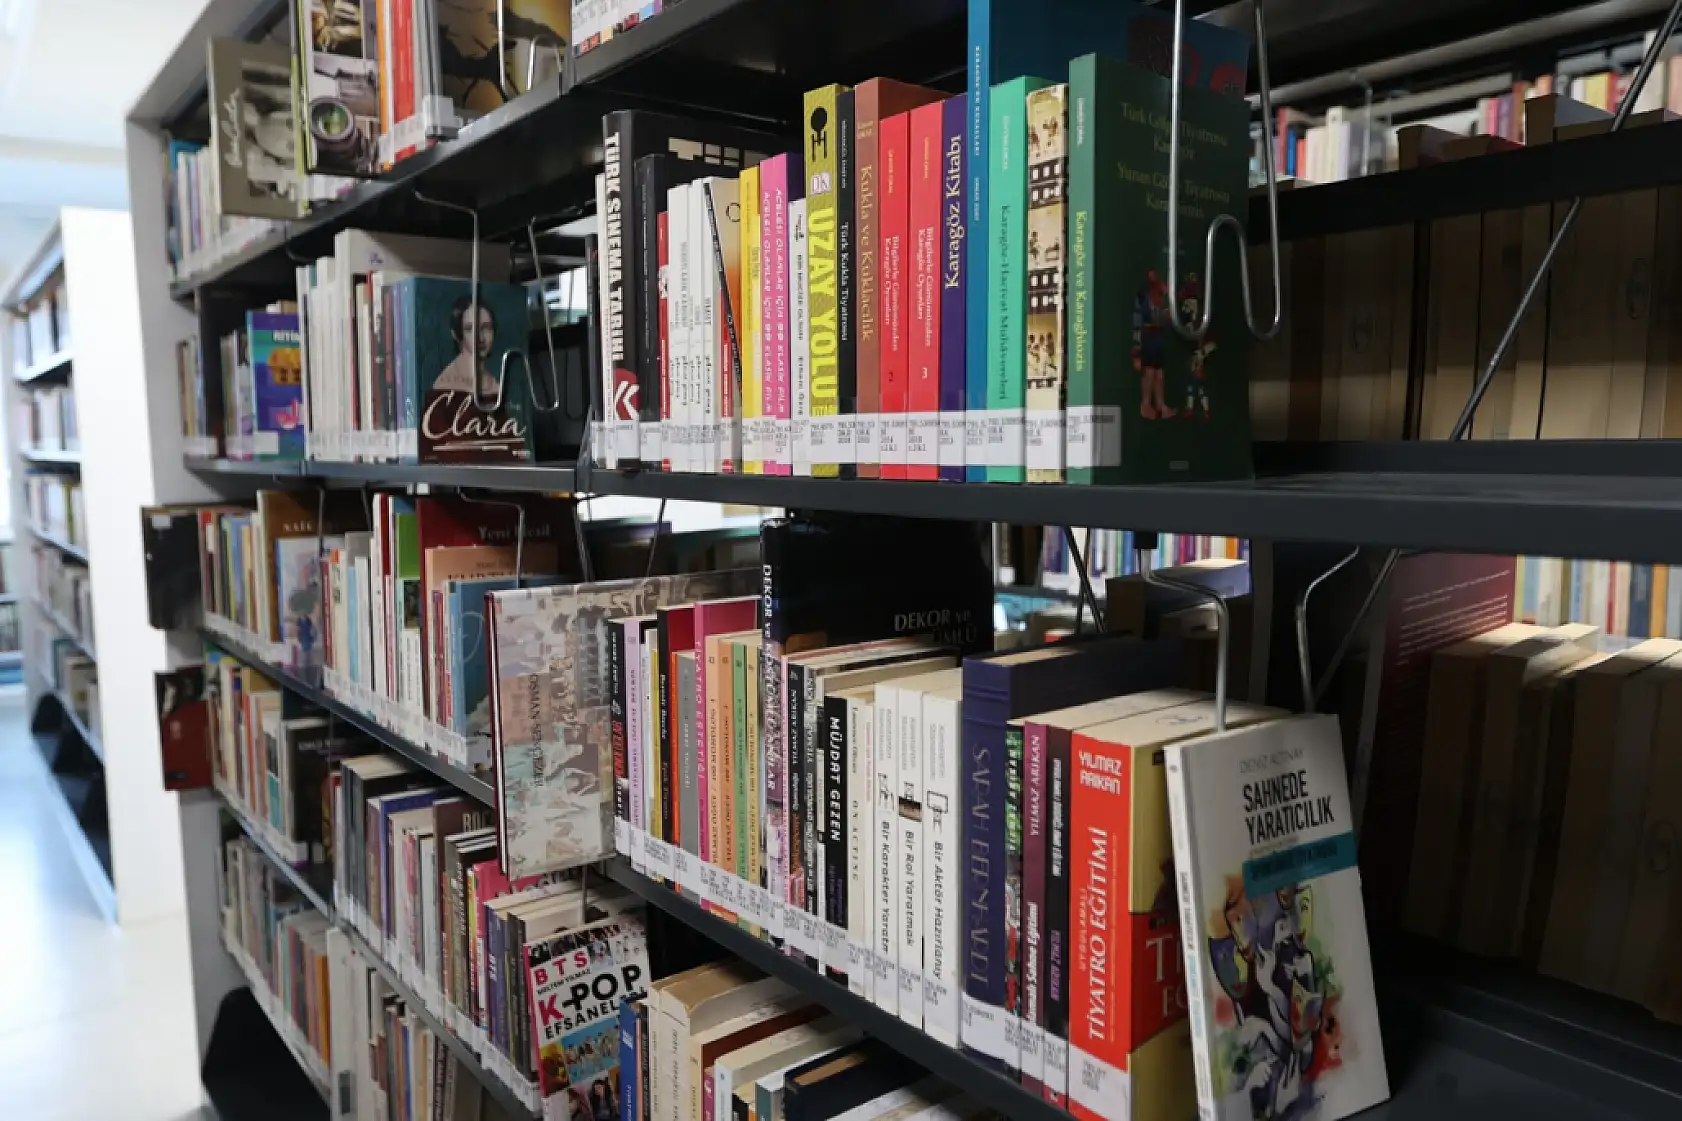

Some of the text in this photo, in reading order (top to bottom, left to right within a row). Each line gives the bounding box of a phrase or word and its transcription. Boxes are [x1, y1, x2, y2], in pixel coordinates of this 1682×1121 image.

[763, 192, 772, 236] ACELESİ
[775, 188, 783, 234] ACELESİ
[944, 134, 961, 289] Karagöz Kitabı
[775, 238, 784, 292] OLANLAR
[807, 207, 834, 297] UZAY
[859, 165, 874, 341] Kukla ve Kuklacılık
[998, 204, 1011, 313] Karagöz-Hacivat
[1074, 211, 1088, 267] Karagöz
[763, 240, 772, 292] OLANLAR
[839, 222, 850, 341] Türk Kukla Tiyatrosu
[1076, 271, 1087, 287] ve
[763, 296, 773, 319] İÇİN
[775, 295, 785, 318] İÇİN
[810, 308, 836, 397] YOLU
[421, 390, 527, 440] Clara
[764, 386, 774, 413] FİLM
[776, 386, 785, 413] FİLM
[762, 564, 773, 618] DEKOR
[764, 620, 773, 638] ve
[893, 609, 951, 632] DEKOR
[528, 673, 541, 720] OSMAN
[829, 717, 843, 842] MÜJDAT GEZEN
[969, 744, 991, 829] SARAH
[1030, 734, 1041, 836] YILMAZ ARIKAN
[1243, 768, 1308, 813] SAHNEDE
[880, 821, 890, 841] Bir
[1244, 795, 1335, 846] YARATICILIK
[880, 844, 890, 903] Karakter
[905, 830, 915, 947] Bir Rol Yaratmak
[932, 841, 944, 980] Bir Aktör Hazırlanıy
[1083, 826, 1109, 1041] TİYATRO EĞİTİMİ
[534, 950, 589, 986] BTS
[538, 964, 642, 1027] K-POP
[544, 998, 622, 1041] EFSANEL
